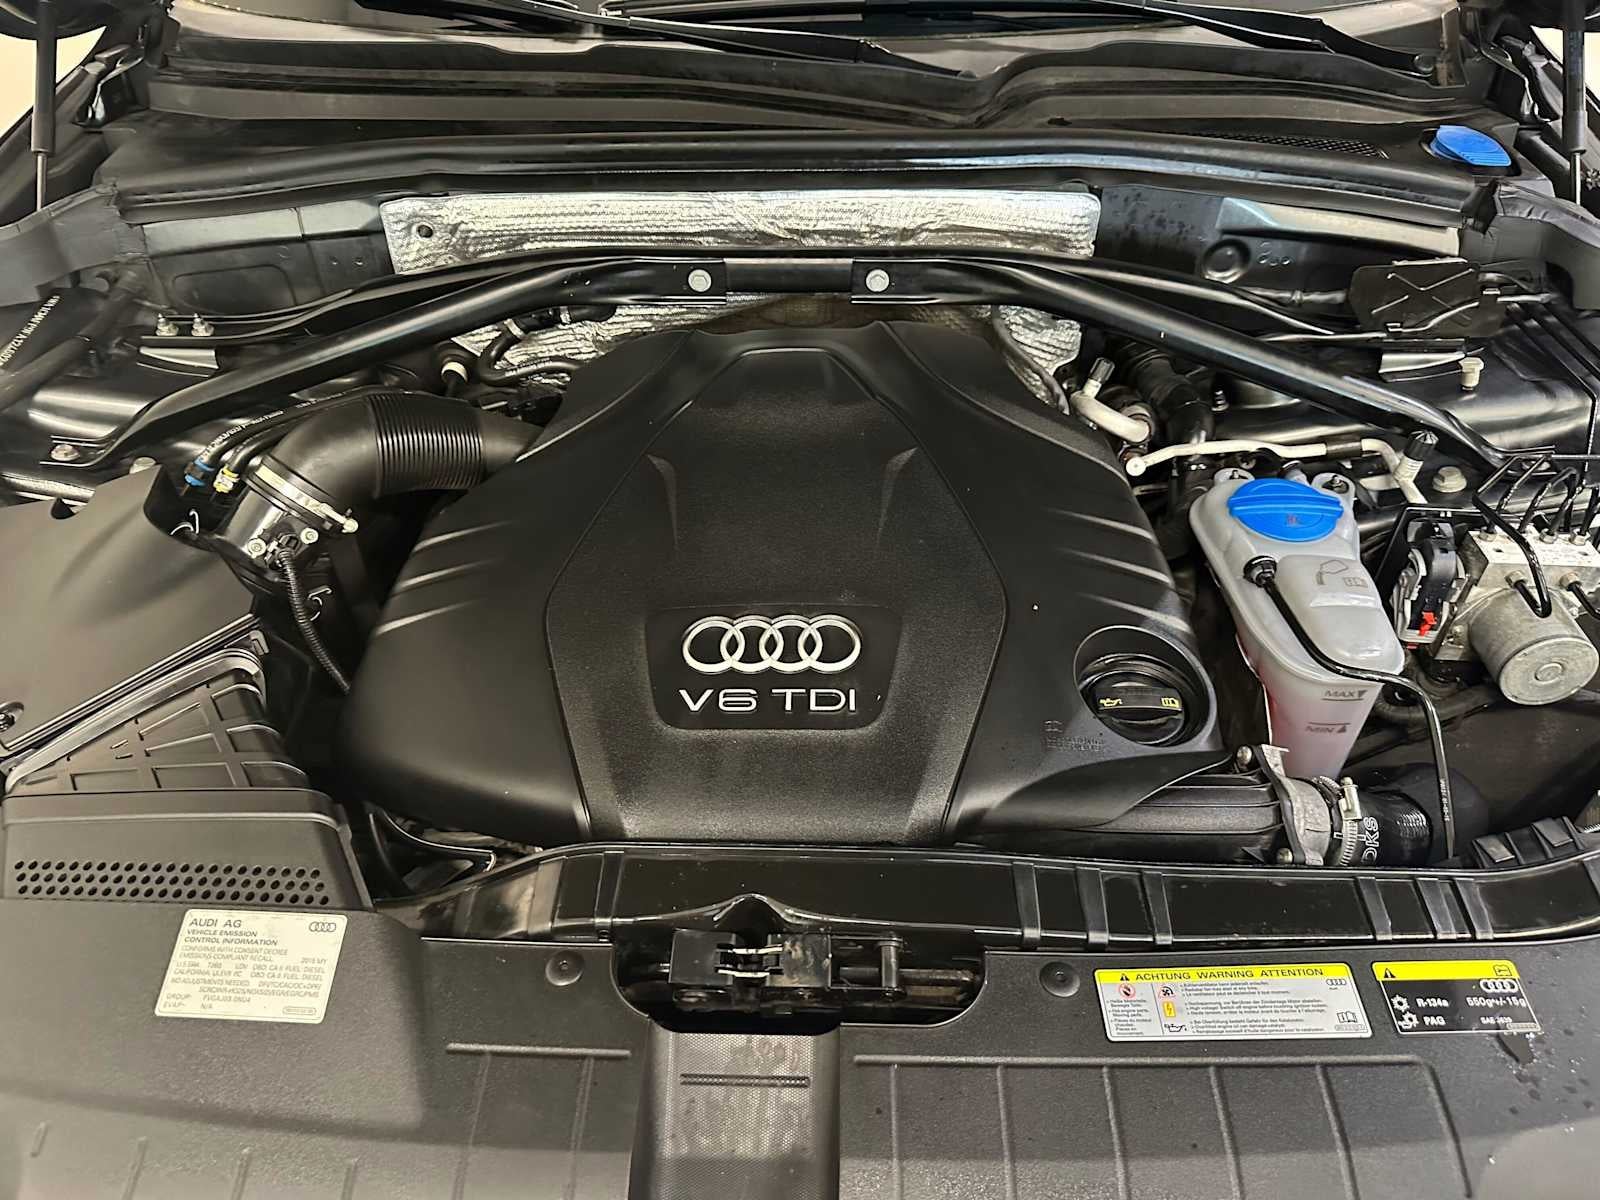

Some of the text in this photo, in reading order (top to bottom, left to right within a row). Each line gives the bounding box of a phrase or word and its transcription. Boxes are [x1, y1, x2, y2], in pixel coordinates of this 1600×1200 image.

[1324, 690, 1357, 698] MAX
[679, 688, 856, 711] V6 TDI
[1305, 725, 1335, 734] MIN
[189, 918, 243, 928] AUDI AG
[184, 936, 278, 946] CONTROL INFORMATION
[1135, 968, 1324, 981] ACHTUNG WARNING ATTENTION
[1423, 1015, 1446, 1026] PAG
